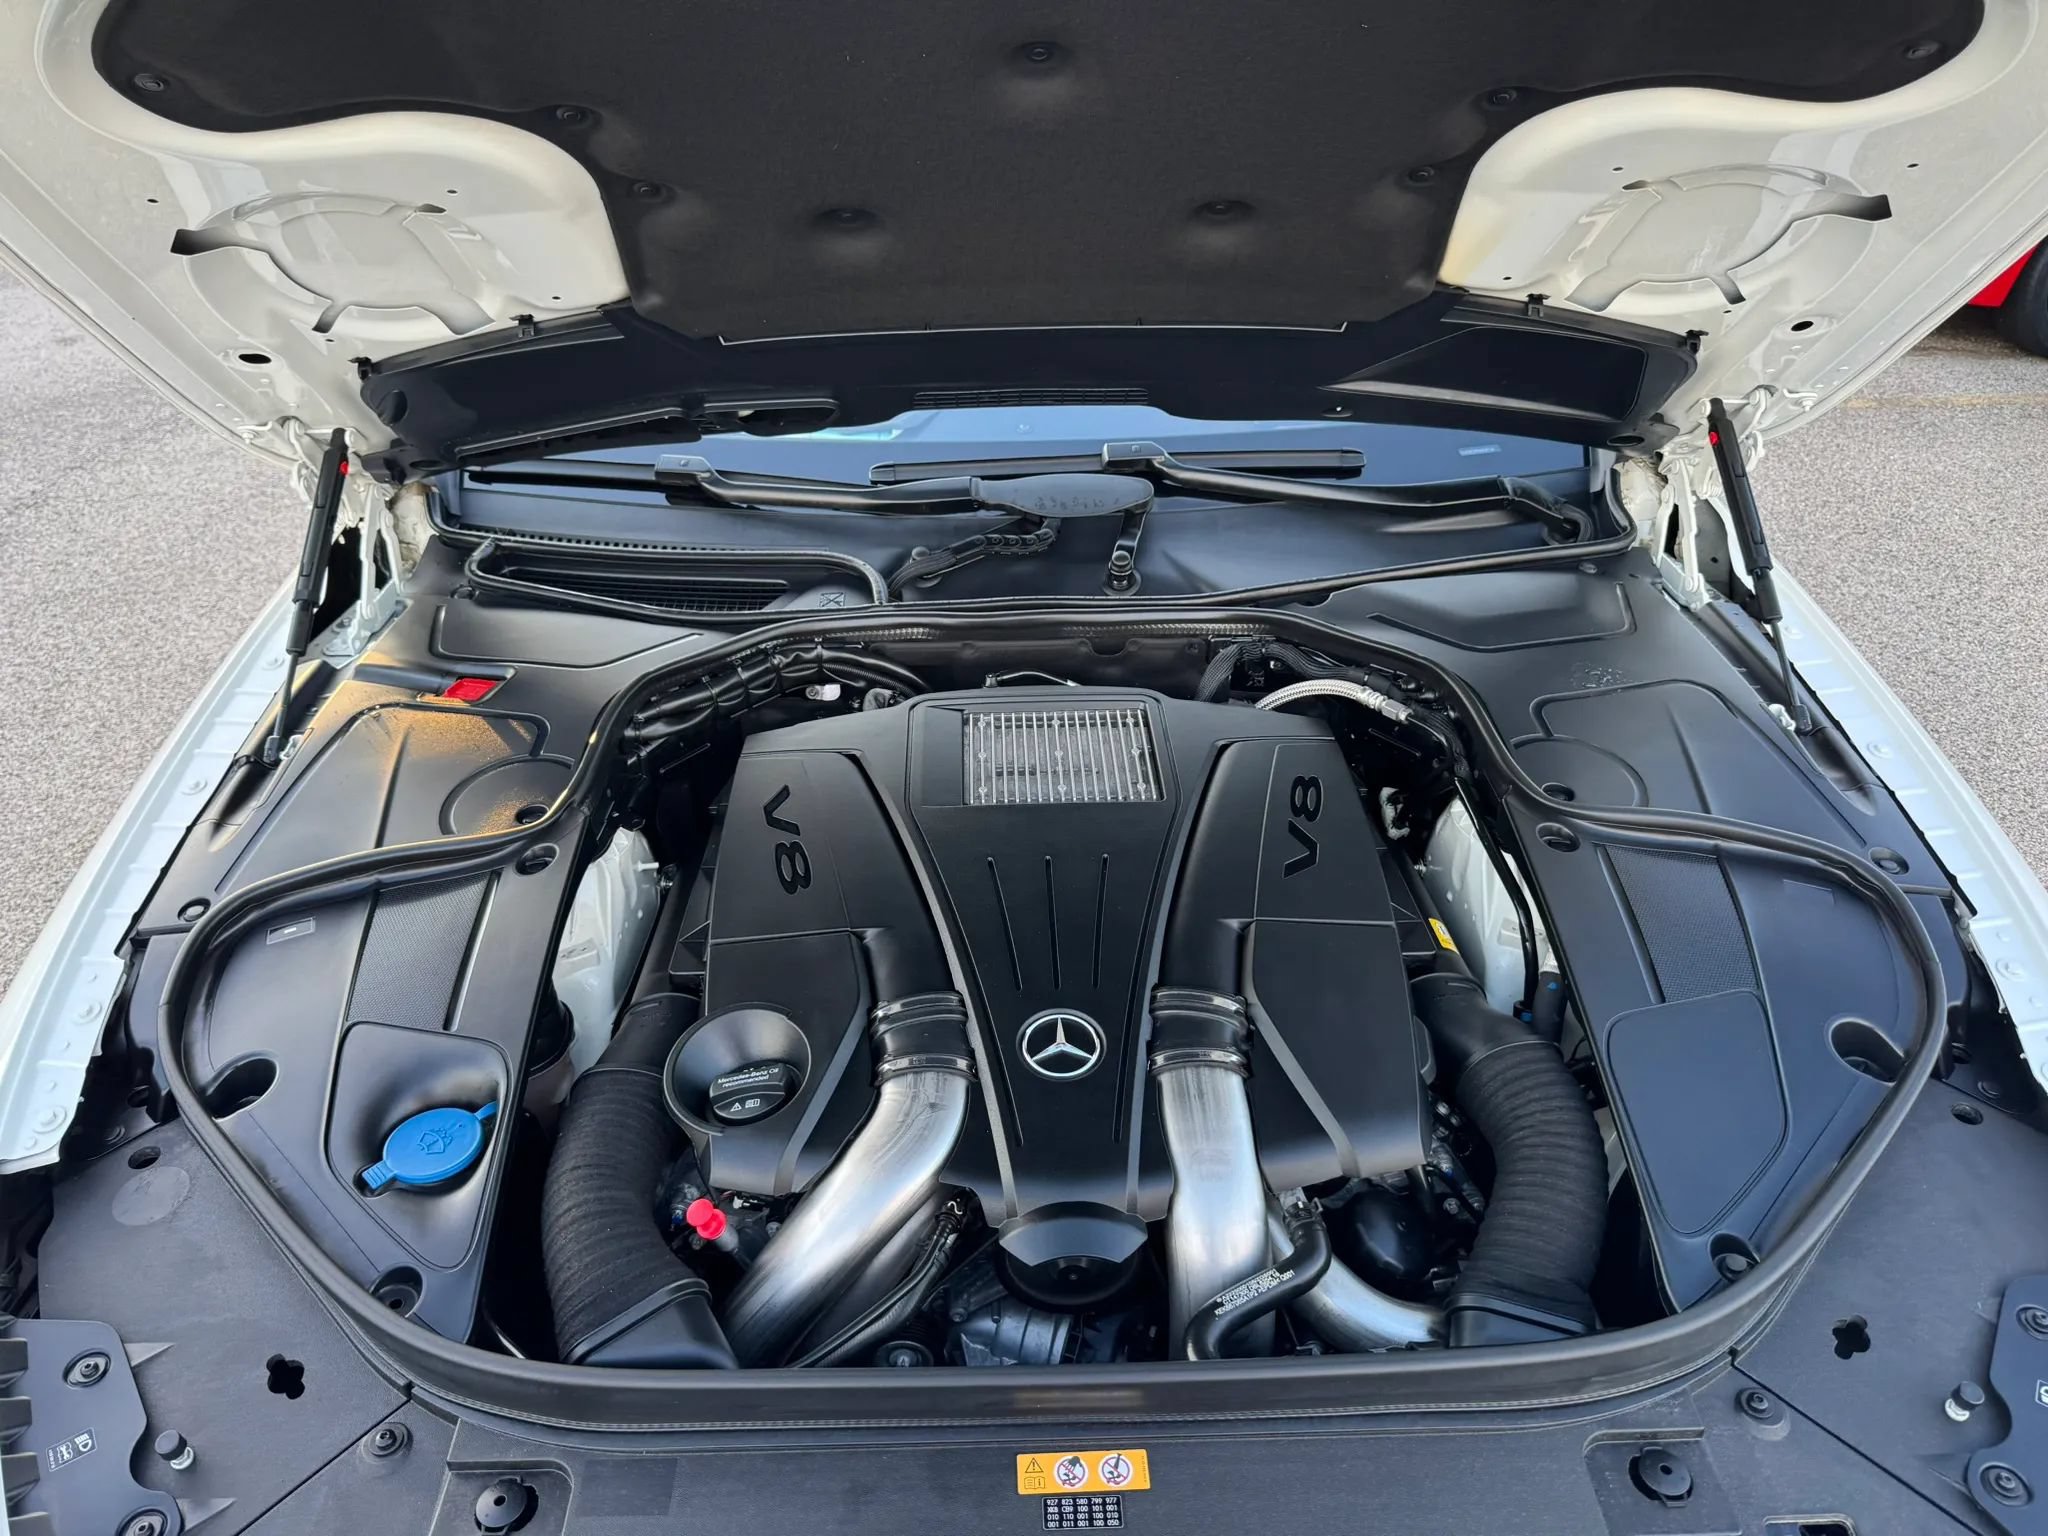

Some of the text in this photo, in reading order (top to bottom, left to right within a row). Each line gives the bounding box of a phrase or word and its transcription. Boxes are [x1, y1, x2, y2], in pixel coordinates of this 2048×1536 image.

[763, 784, 812, 895] V8
[1282, 775, 1324, 879] V8
[717, 1070, 768, 1084] Mercedes-Benz
[722, 1074, 769, 1088] recommended
